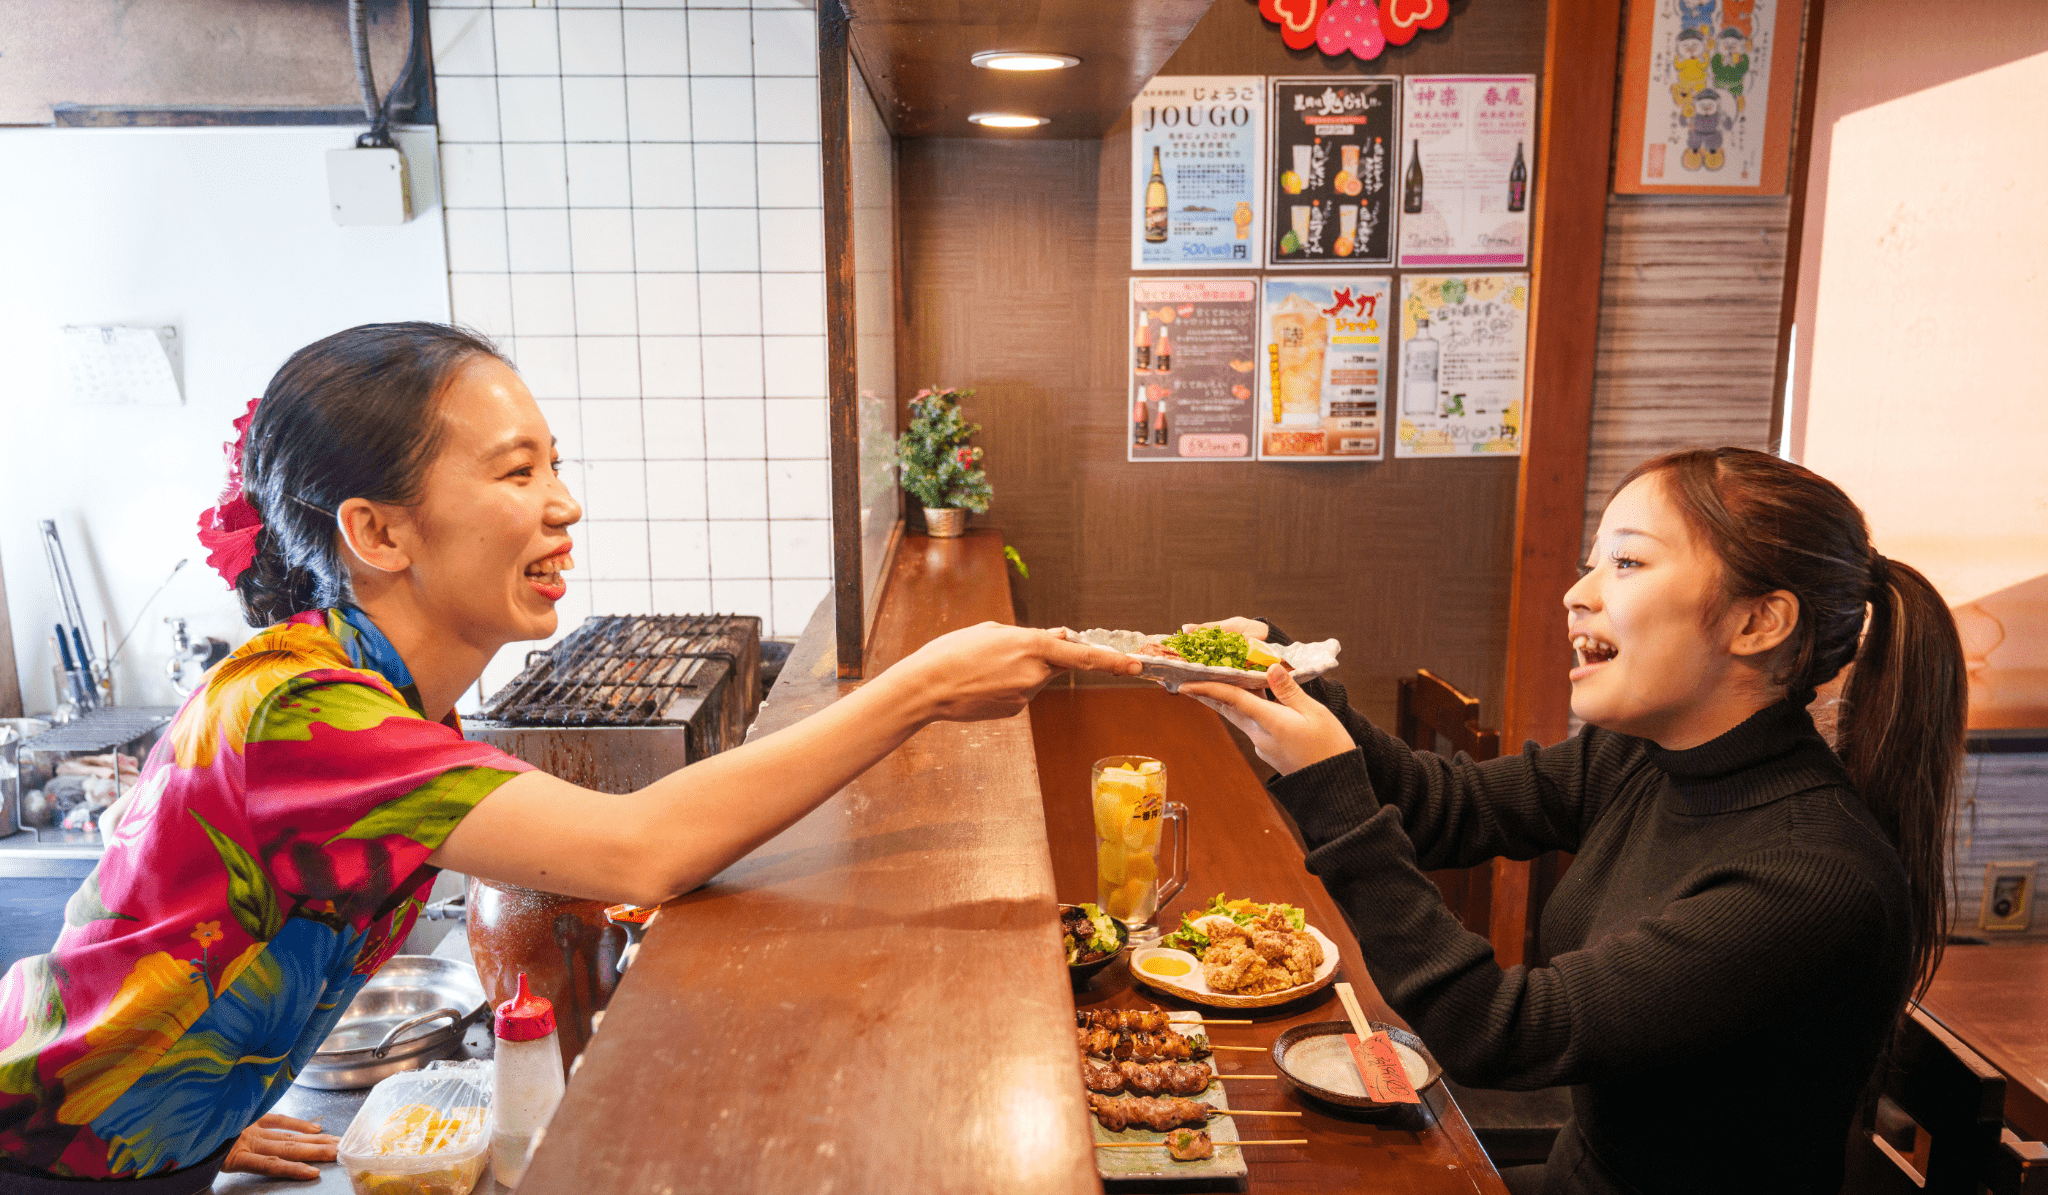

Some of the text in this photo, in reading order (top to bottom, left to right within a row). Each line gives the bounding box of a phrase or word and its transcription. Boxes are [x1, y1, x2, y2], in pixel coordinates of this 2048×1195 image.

[1193, 87, 1254, 102] じょうご
[1144, 105, 1249, 132] JOUGO
[1233, 245, 1247, 260] 円
[1323, 286, 1383, 318] メガ
[1335, 318, 1378, 332] ジョッキ
